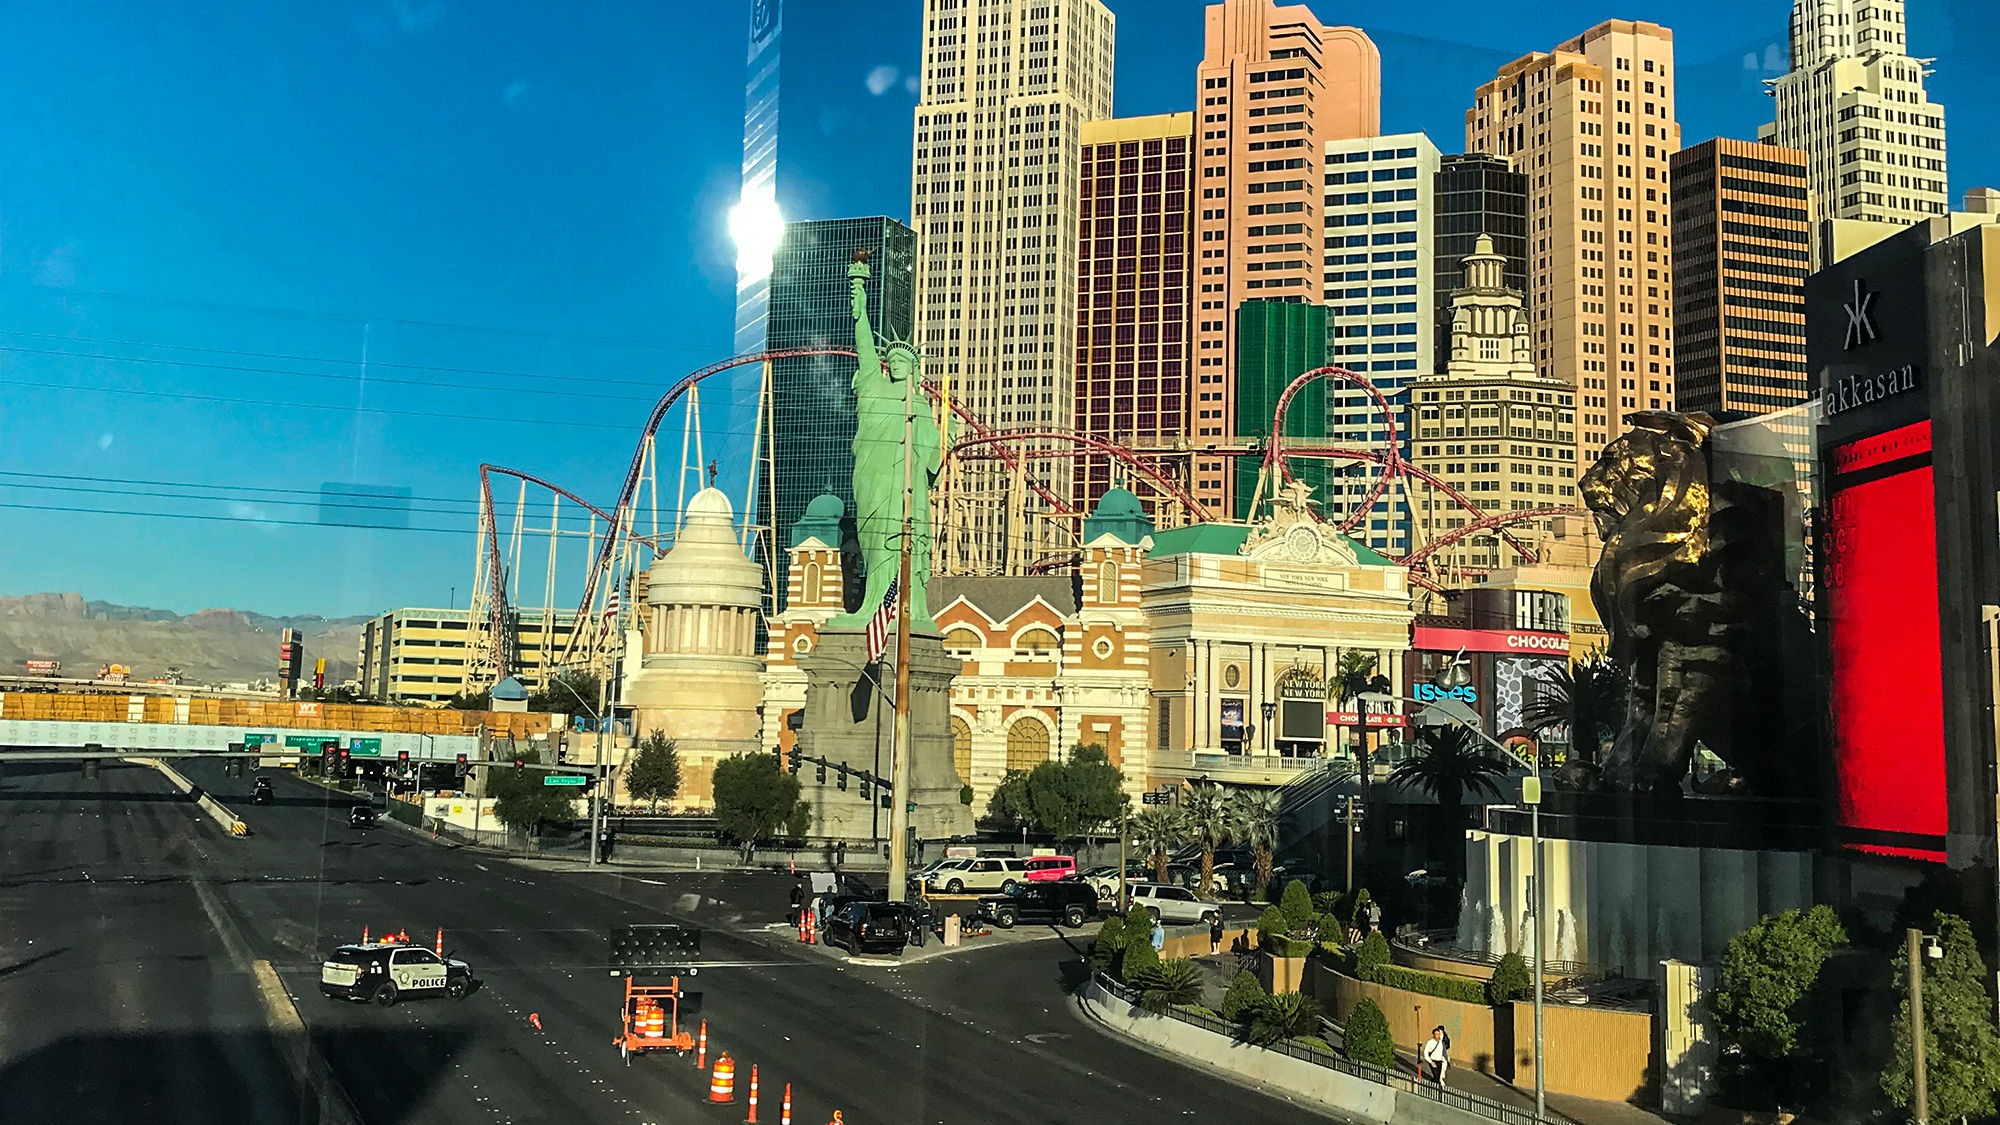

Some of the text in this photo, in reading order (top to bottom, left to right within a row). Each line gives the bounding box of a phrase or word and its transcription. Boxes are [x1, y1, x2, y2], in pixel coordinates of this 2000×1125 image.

[1811, 364, 1915, 421] Hakkasan
[1284, 680, 1326, 690] NEW YORK
[1284, 688, 1326, 698] NEW YORK
[299, 703, 318, 711] WT
[1339, 714, 1382, 723] CHOLATE
[412, 978, 446, 988] POLICE
